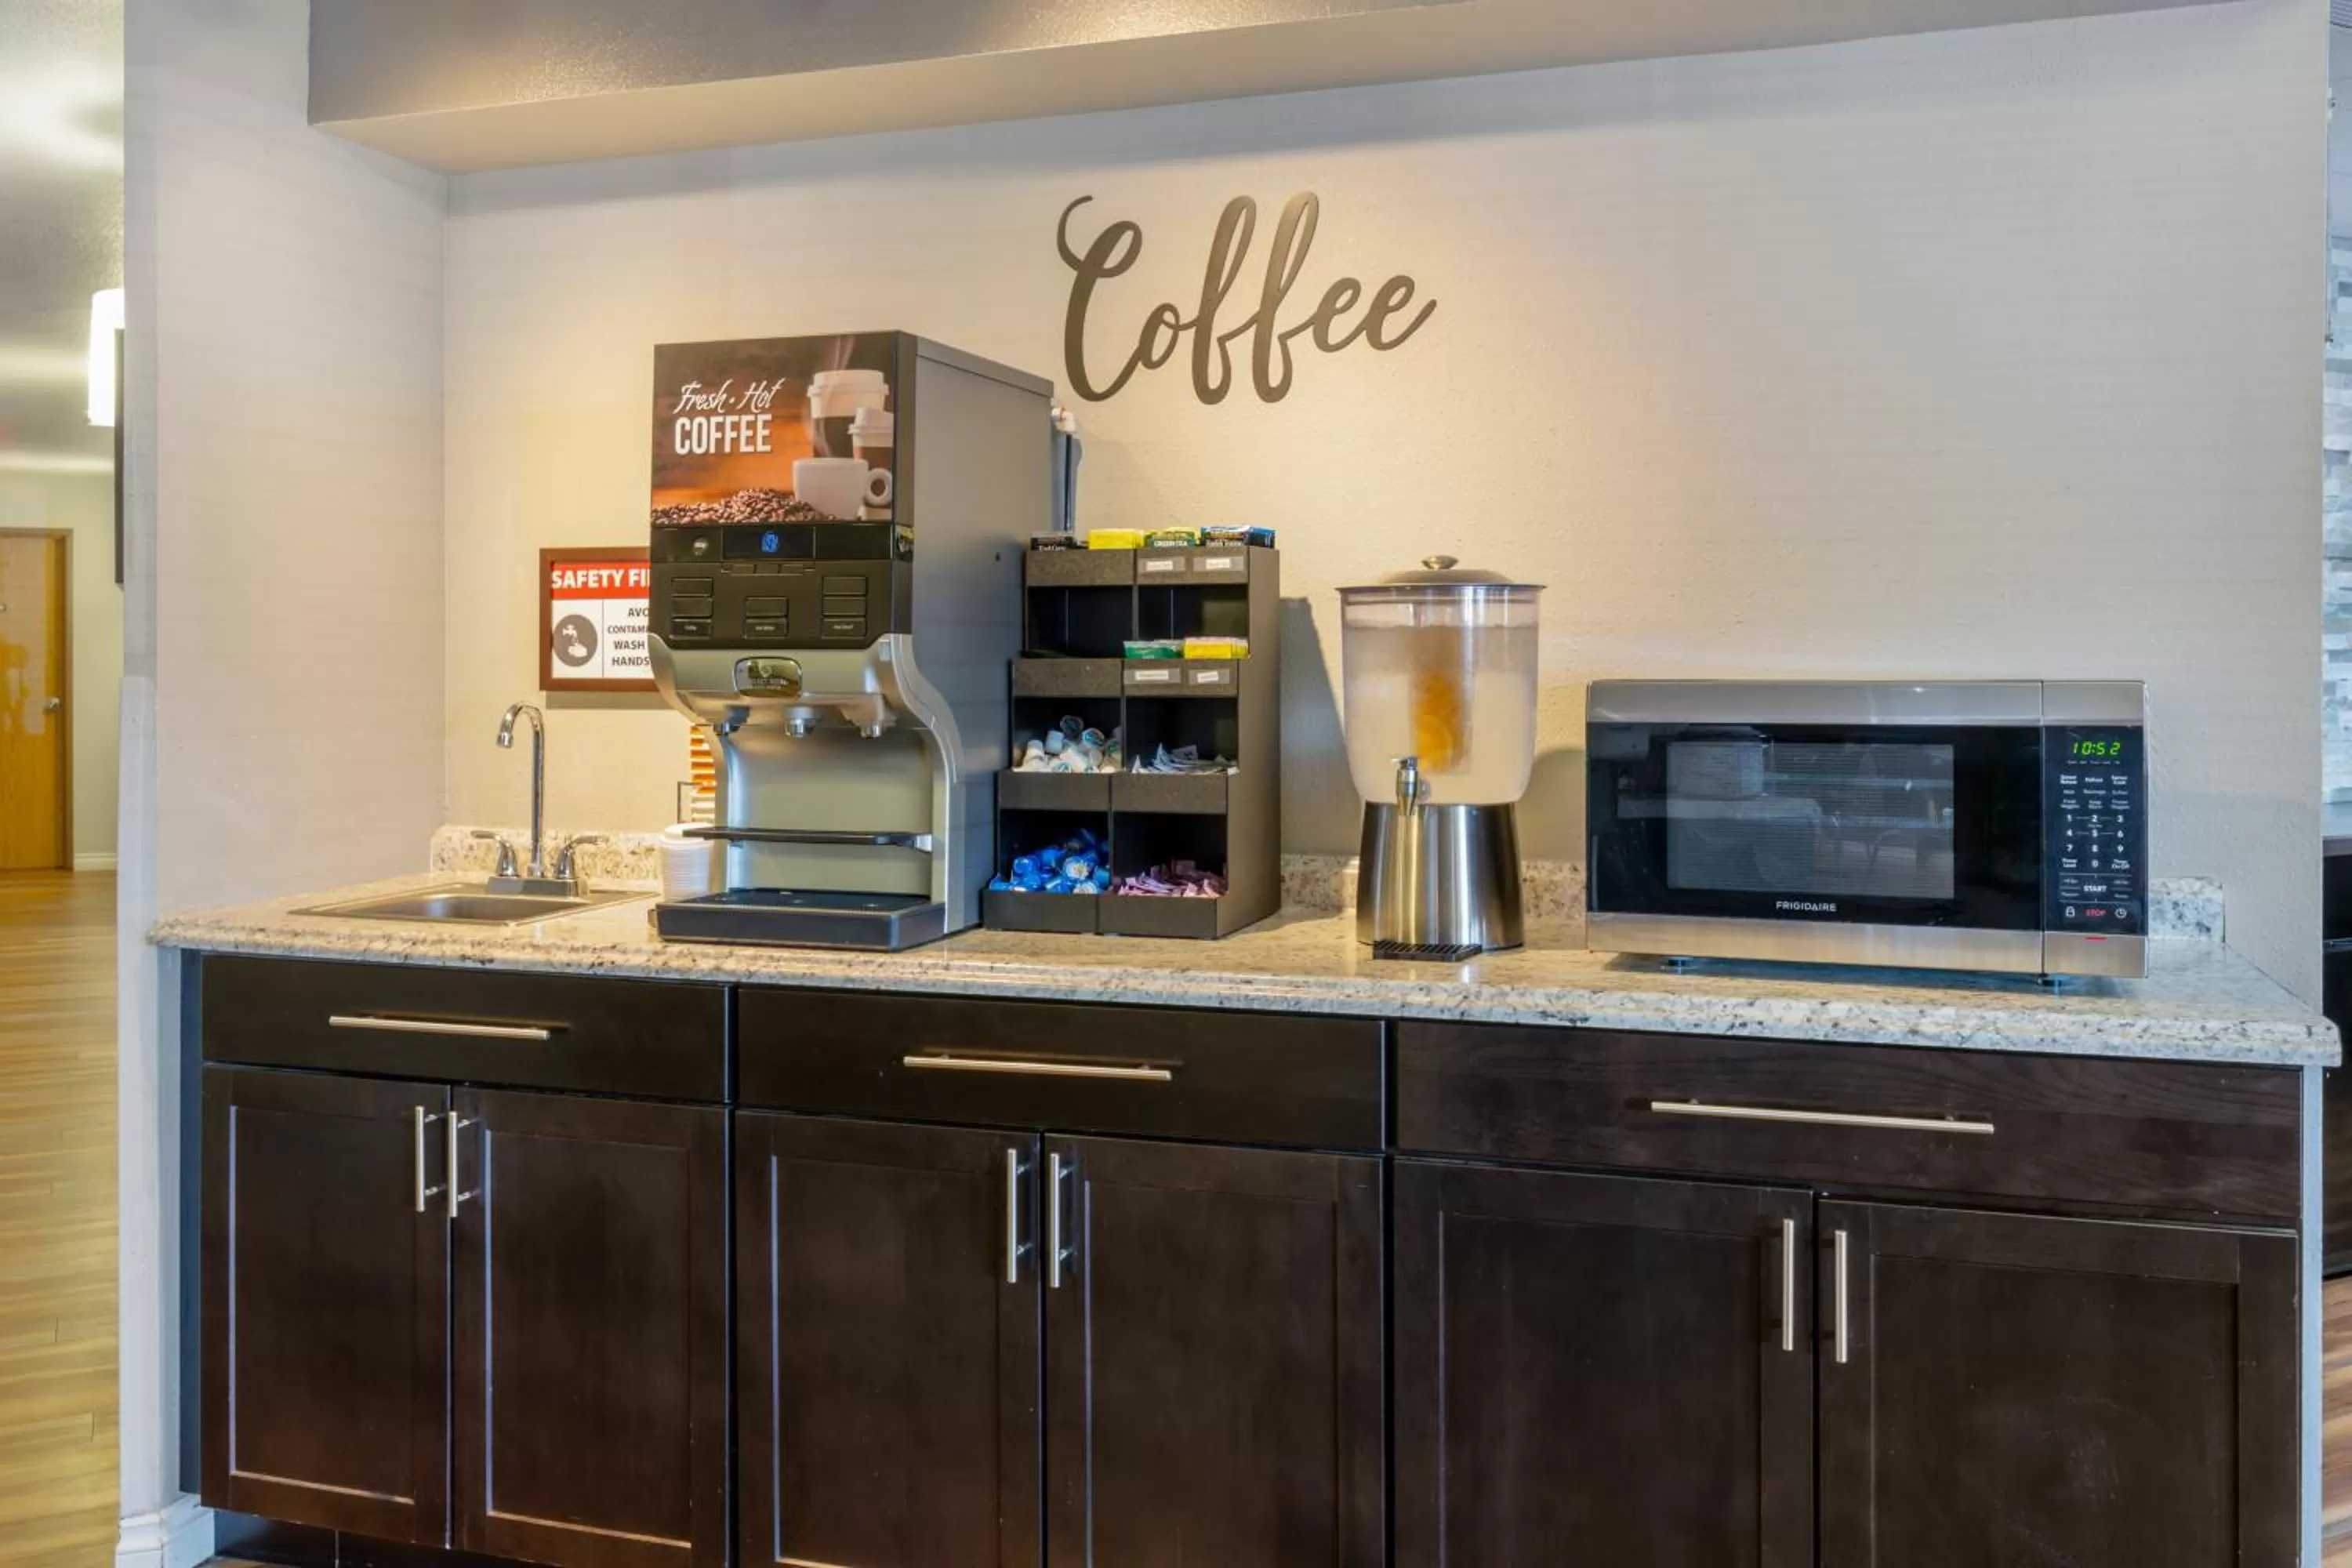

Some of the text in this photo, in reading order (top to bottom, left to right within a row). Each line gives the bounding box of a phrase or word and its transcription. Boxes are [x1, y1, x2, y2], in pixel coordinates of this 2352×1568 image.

[1057, 191, 1437, 405] Coffee
[673, 376, 786, 415] Fresh Hot
[675, 413, 772, 456] COFFEE
[551, 568, 650, 589] SAFETY FI
[608, 625, 649, 634] CONTAM
[613, 640, 645, 650] WASH
[612, 656, 650, 666] HANDS
[2072, 741, 2121, 755] 10:52
[1775, 901, 1837, 912] FRIGIDAIRE
